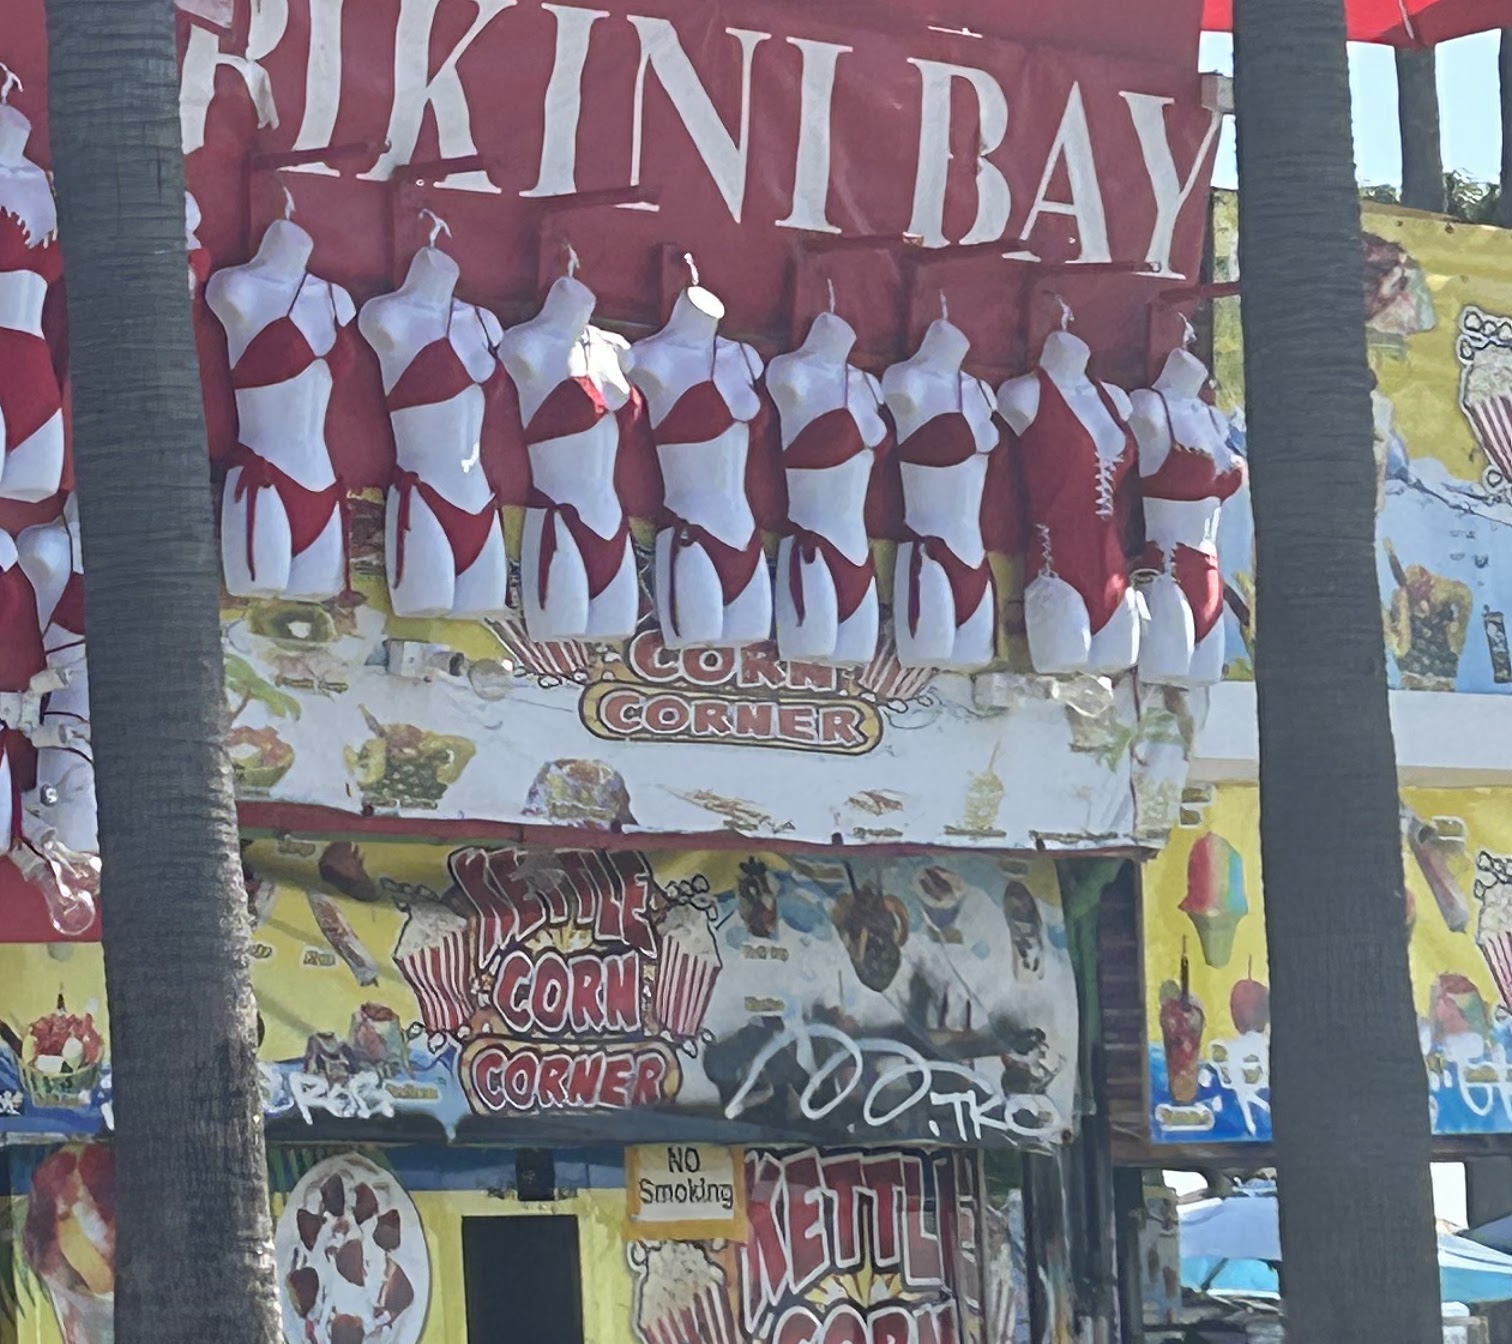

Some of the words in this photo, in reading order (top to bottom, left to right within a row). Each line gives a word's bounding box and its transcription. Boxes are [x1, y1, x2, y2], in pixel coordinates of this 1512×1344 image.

[908, 57, 1222, 280] BAY
[598, 689, 870, 746] CORNER
[493, 950, 641, 1034] CORN
[472, 1048, 667, 1110] CORNER
[667, 1146, 701, 1174] NO
[639, 1178, 734, 1210] Smoking
